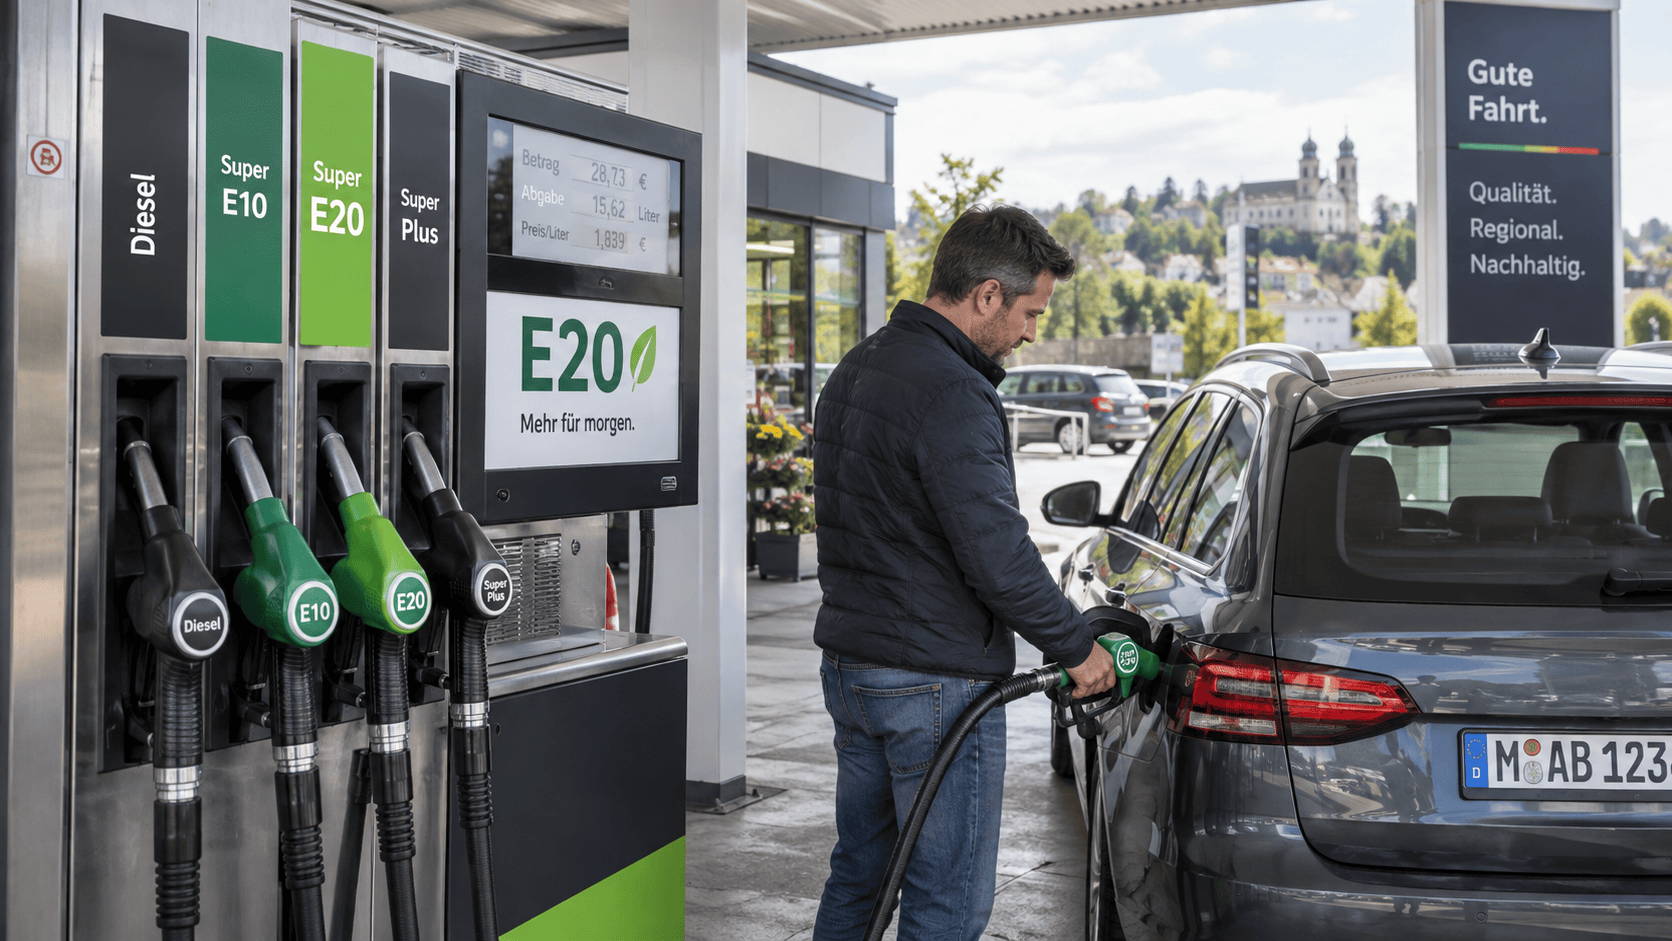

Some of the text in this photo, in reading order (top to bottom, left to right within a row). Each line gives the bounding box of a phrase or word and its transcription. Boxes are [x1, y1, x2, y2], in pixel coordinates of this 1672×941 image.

[1467, 58, 1534, 87] Gute
[1468, 95, 1548, 124] Fahrt.
[221, 154, 270, 181] Super
[313, 160, 362, 190] Super
[522, 148, 647, 191] Betrag 28,73 €
[222, 188, 268, 219] E10
[400, 188, 440, 213] Super
[521, 184, 661, 224] Abgabe 15,62 Liter
[1469, 181, 1557, 205] Qualität.
[130, 173, 155, 256] Diesel
[310, 196, 365, 237] E20
[401, 218, 439, 245] Plus
[521, 220, 647, 252] Preis/Liter 1,839 €
[1470, 217, 1563, 244] Regional.
[1470, 253, 1586, 281] Nachhaltig.
[521, 315, 624, 394] E20
[520, 412, 635, 436] Mehr für morgen.
[484, 579, 508, 591] Super
[487, 591, 505, 602] Plus
[299, 601, 331, 623] E10
[397, 590, 425, 612] E20
[184, 615, 222, 634] Diesel
[1472, 767, 1481, 779] D
[1495, 740, 1672, 783] M AB 123
